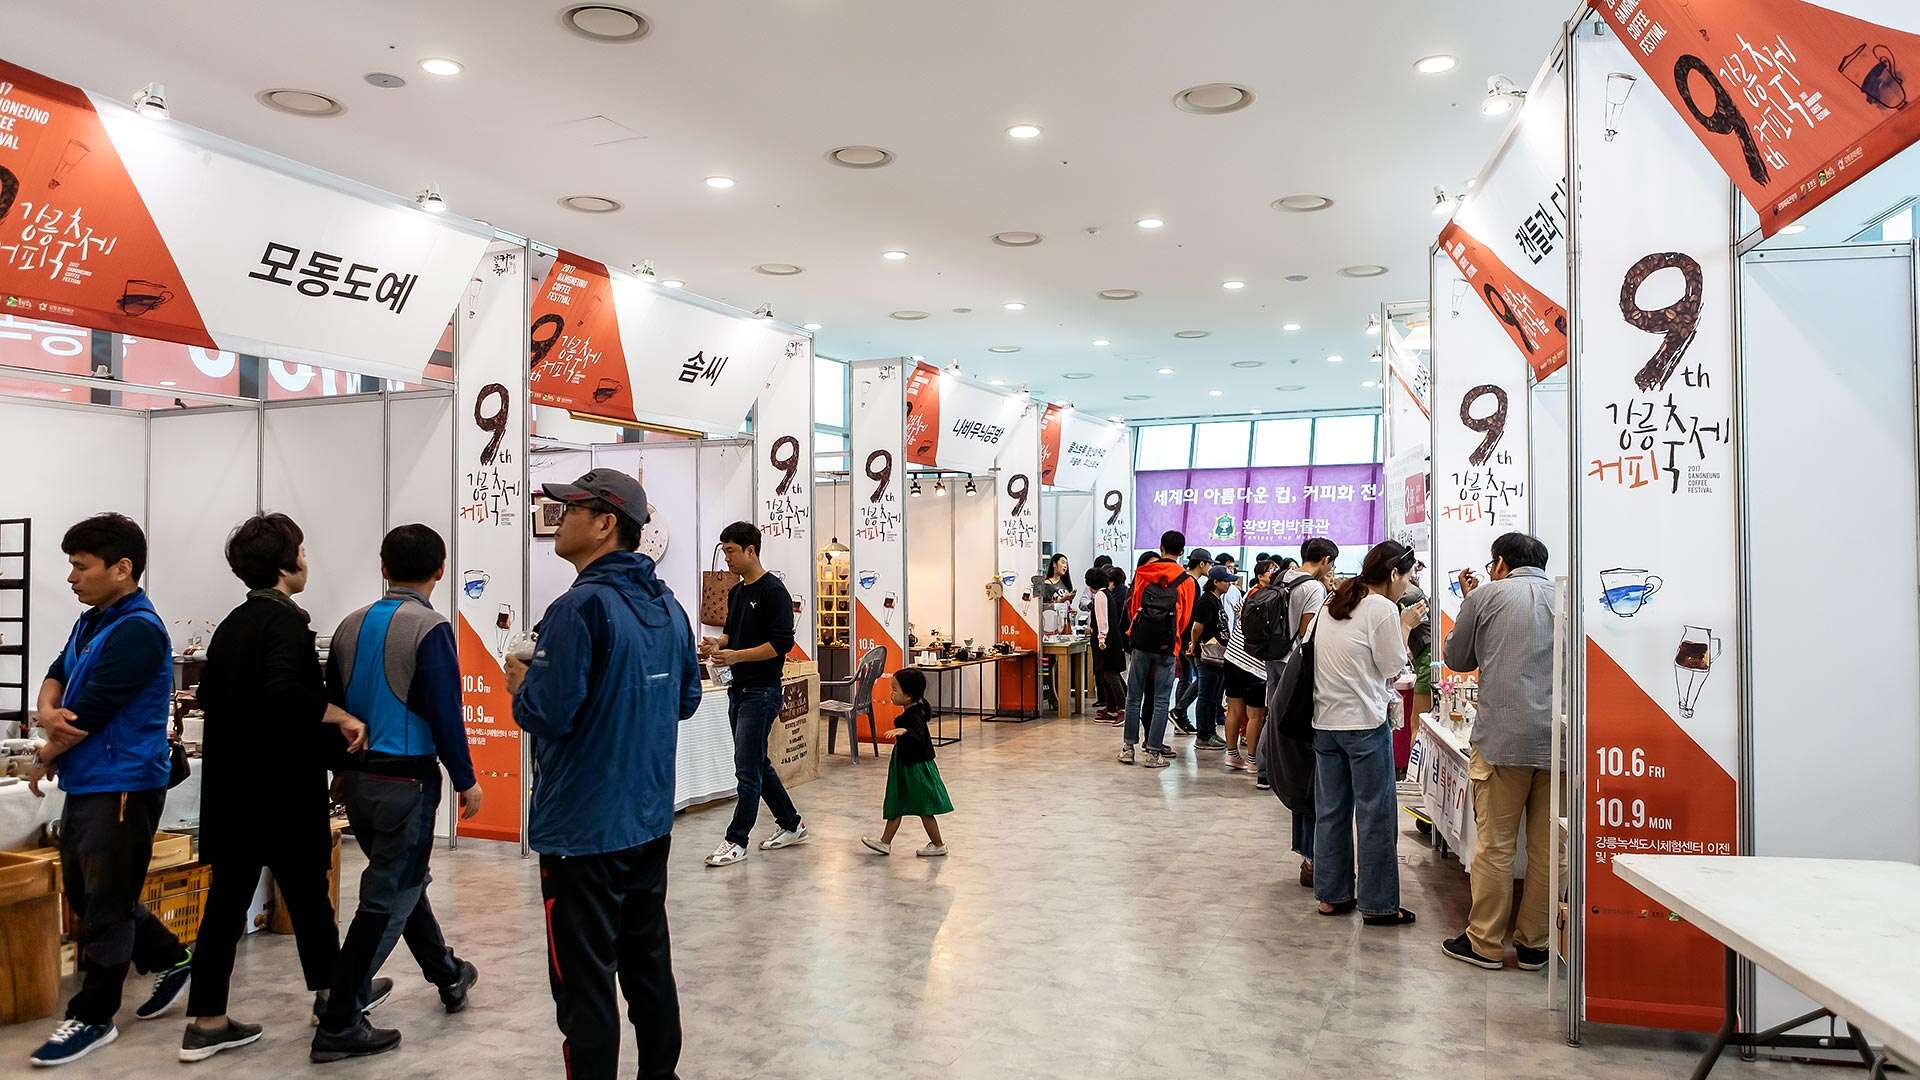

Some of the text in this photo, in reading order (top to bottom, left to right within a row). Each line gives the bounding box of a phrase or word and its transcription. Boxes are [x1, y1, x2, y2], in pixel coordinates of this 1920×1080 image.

[1626, 9, 1650, 41] COFFEE
[1638, 21, 1668, 57] FESTIVAL
[249, 241, 418, 315] 모동도예
[678, 351, 728, 386] 솜씨
[953, 418, 1005, 444] 나비무늬공방
[1153, 488, 1199, 506] 세계의
[1204, 486, 1269, 505] 아름다운
[1303, 484, 1355, 502] 커피화
[462, 675, 484, 693] 10.6
[462, 705, 484, 723] 10.9
[1596, 747, 1665, 778] 10.6 FRI
[1596, 798, 1672, 830] 10.9 MON
[1595, 836, 1730, 855] 강릉녹색도시체험센터 이젠
